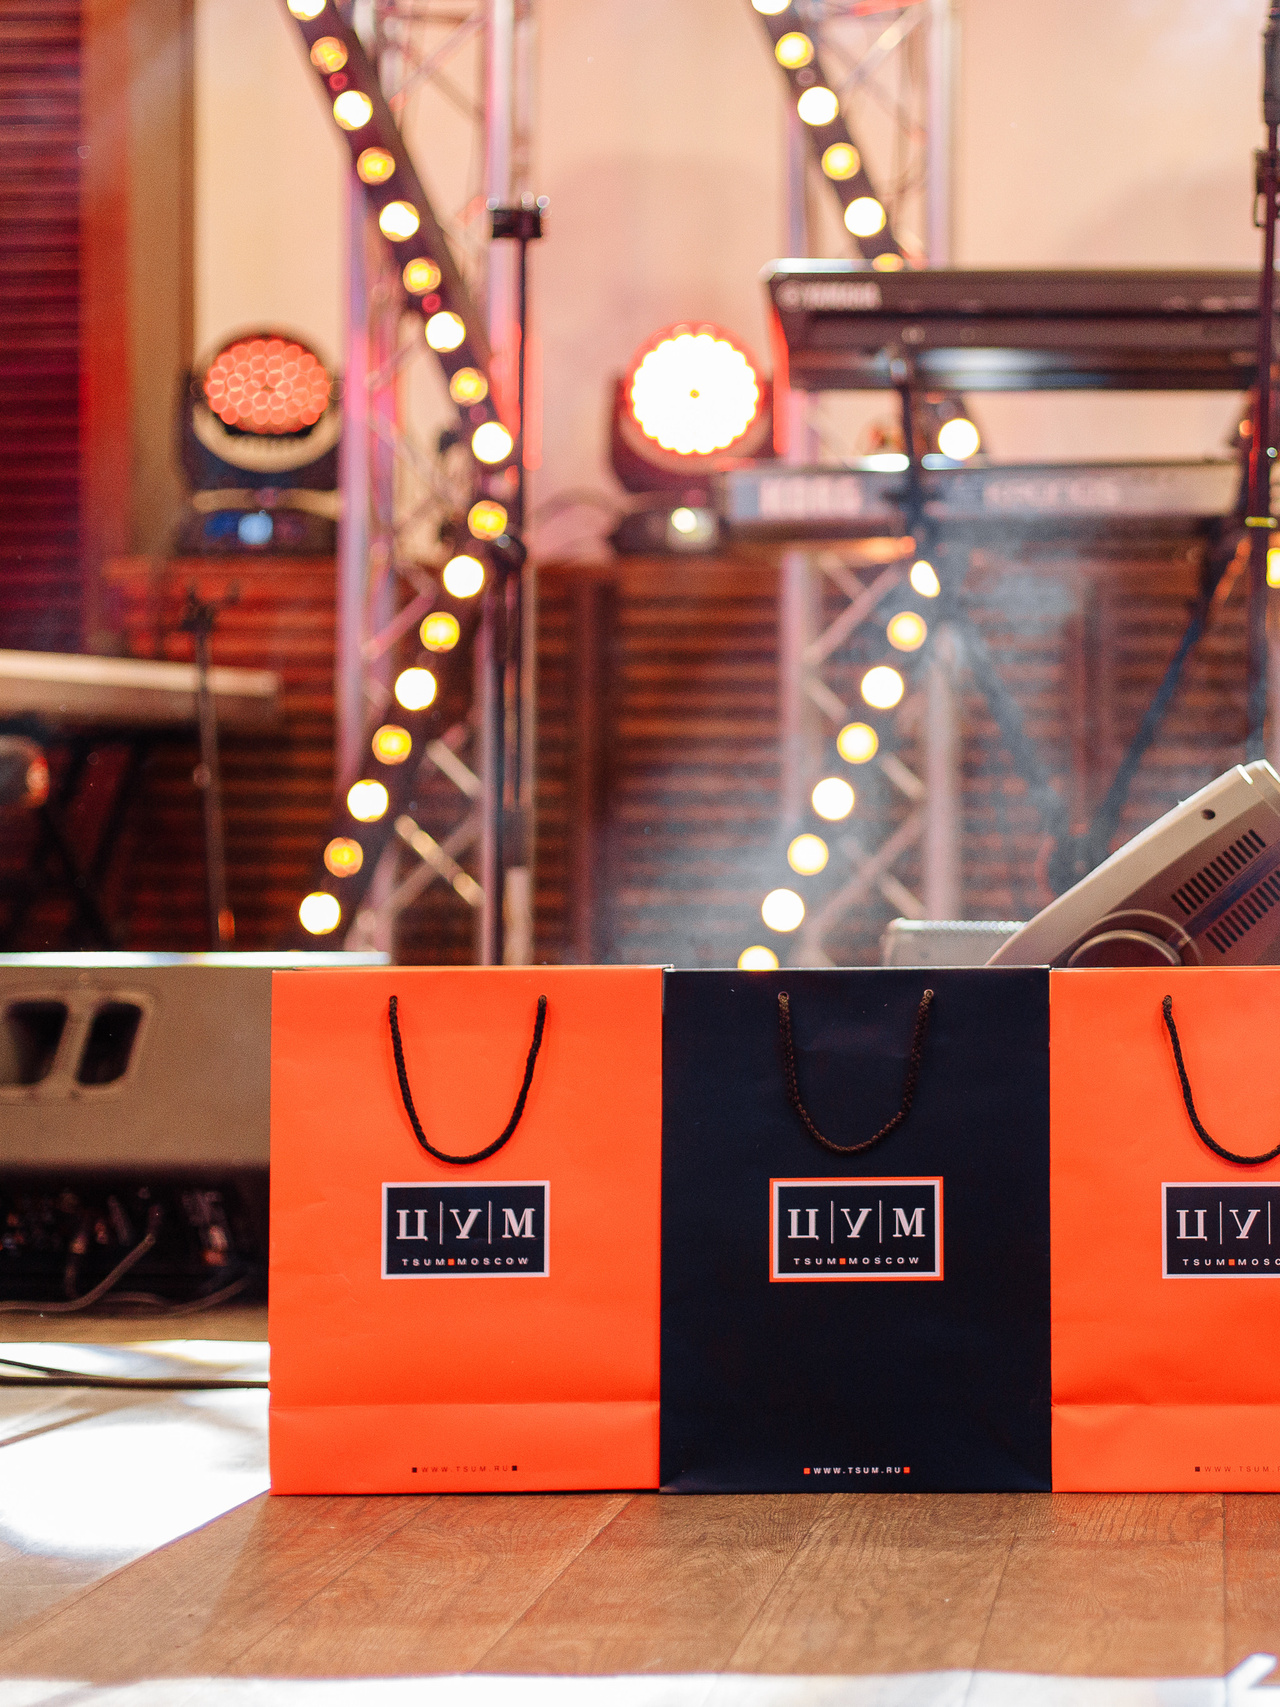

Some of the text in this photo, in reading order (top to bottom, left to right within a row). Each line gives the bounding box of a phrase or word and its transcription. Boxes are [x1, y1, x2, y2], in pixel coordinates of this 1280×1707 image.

[395, 1207, 536, 1241] ЦУМ
[787, 1207, 926, 1241] ЦУМ
[401, 1257, 529, 1267] TSUM MOSCOW
[793, 1256, 919, 1265] TSUM MOSCOW
[1182, 1258, 1225, 1266] TSUM
[421, 1465, 509, 1473] WWW.TSUM.RU
[813, 1466, 901, 1474] WWW.TSUM.RU
